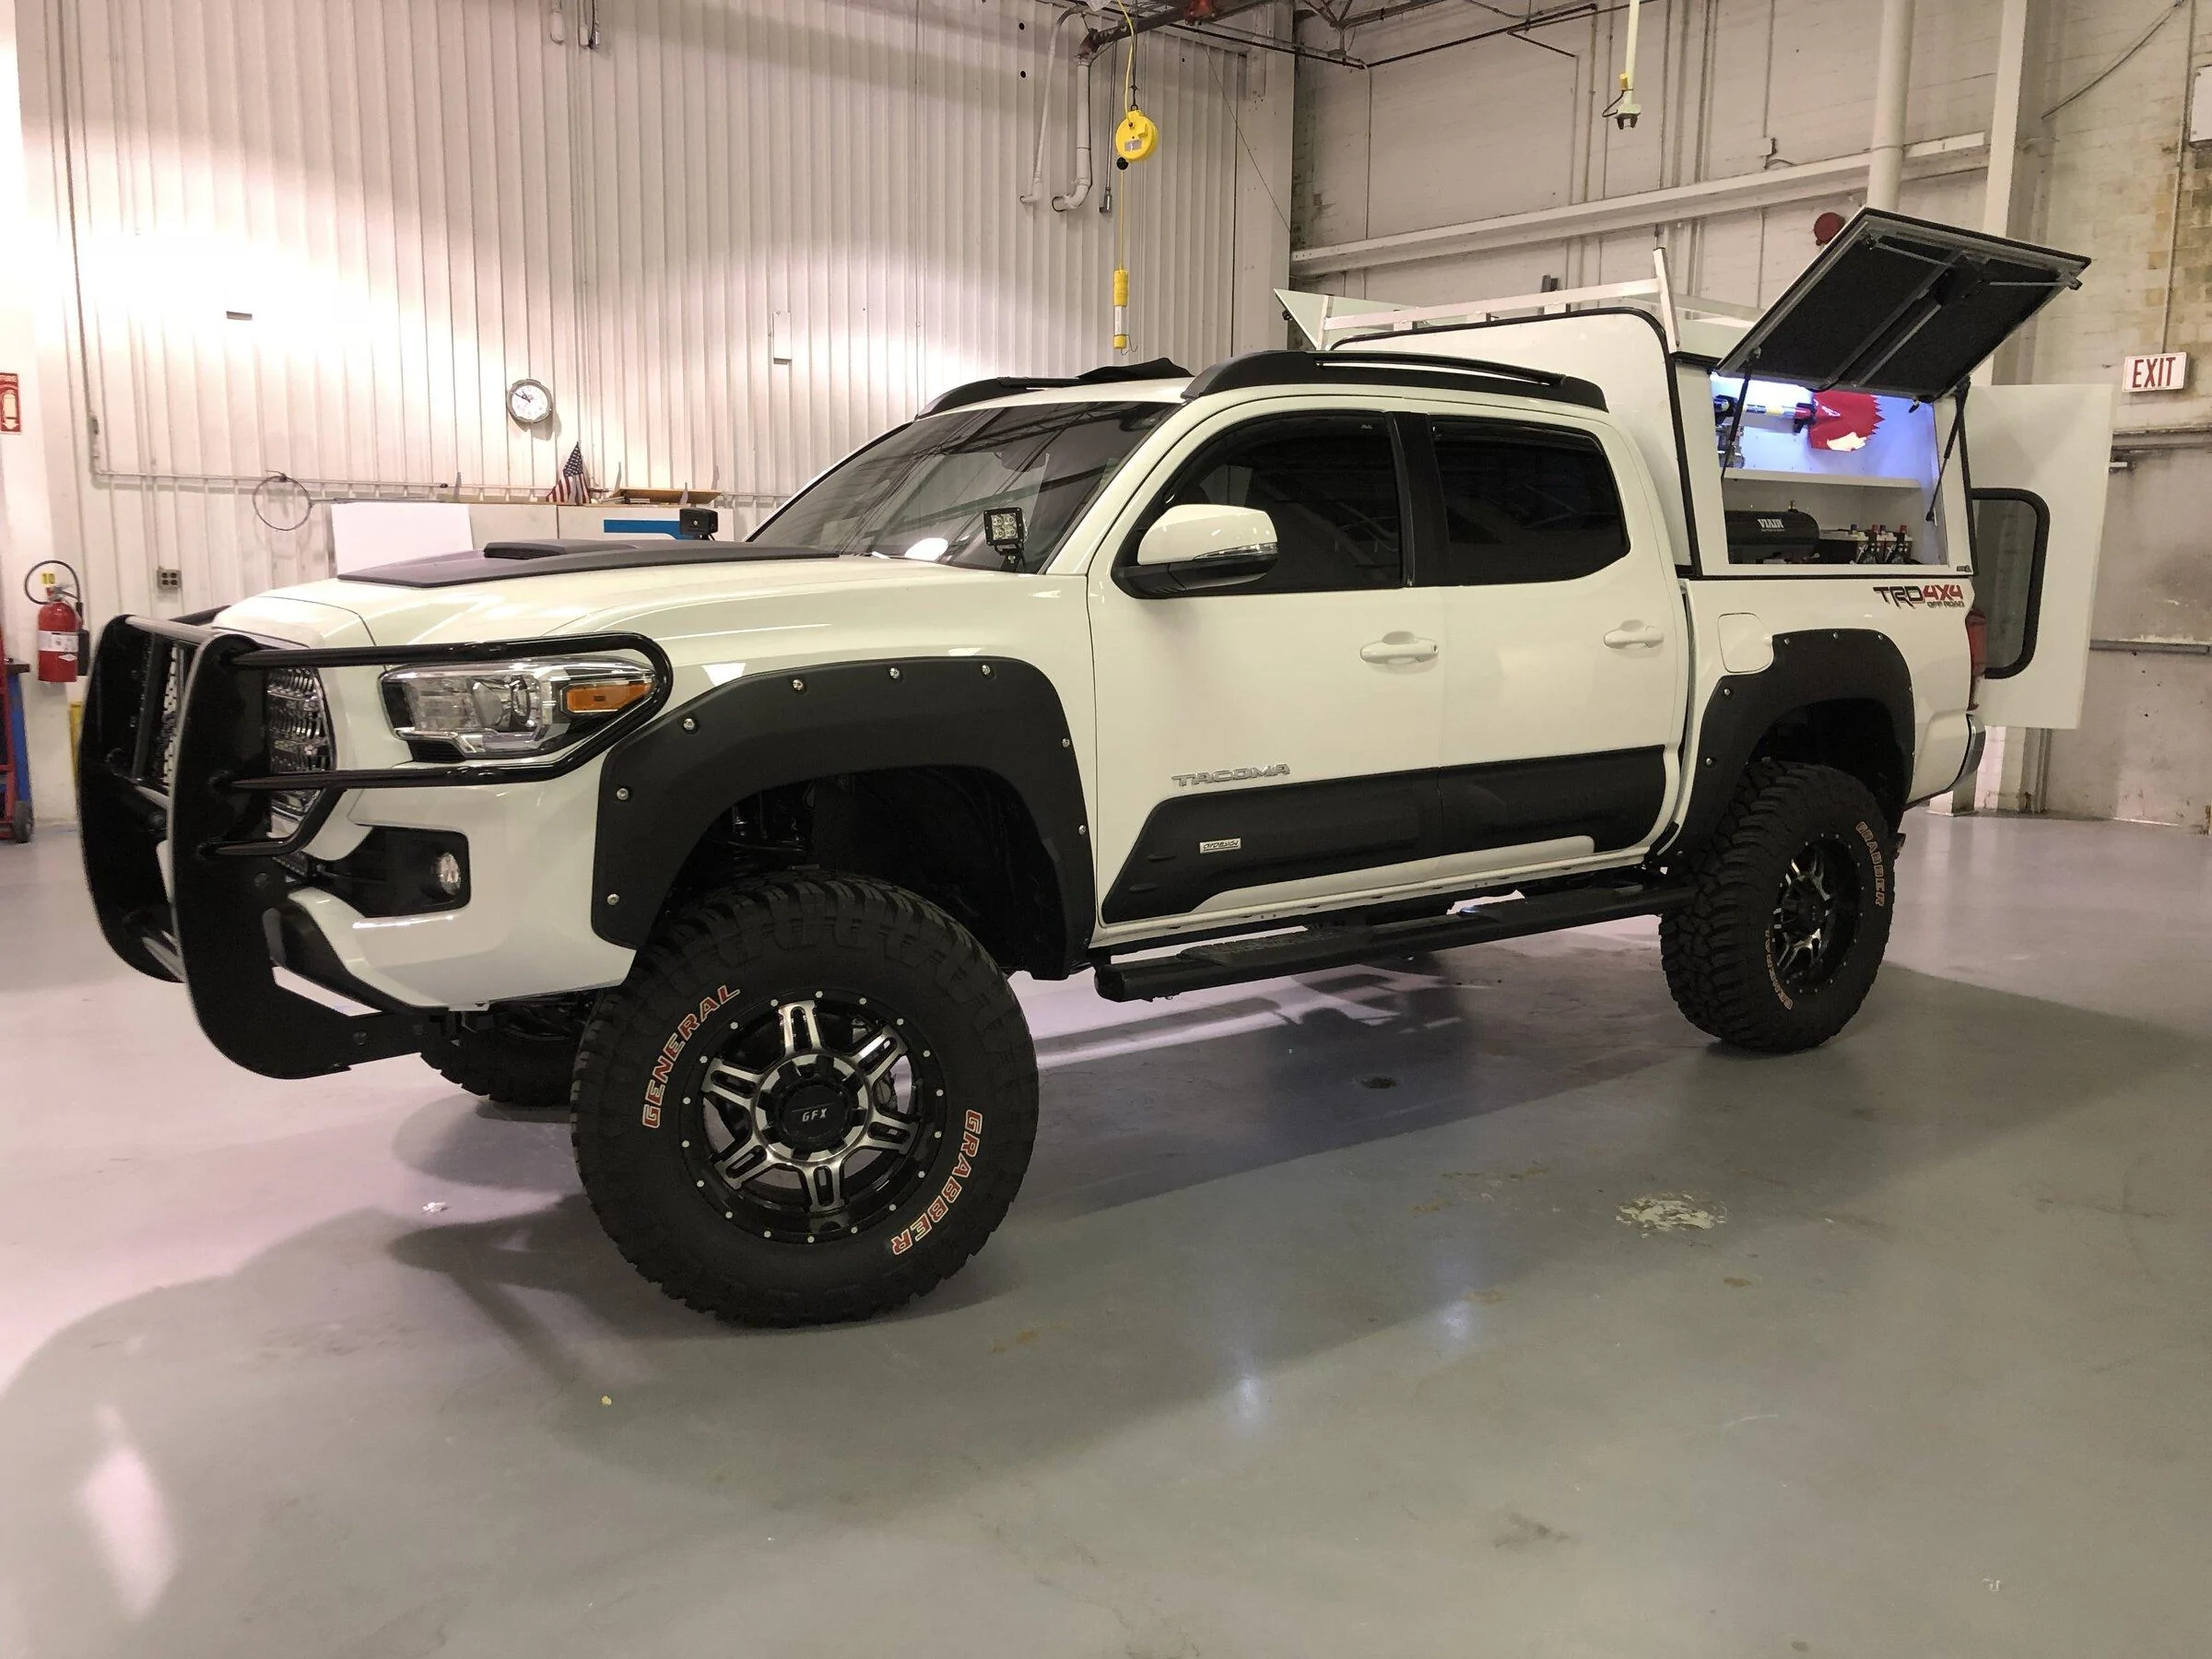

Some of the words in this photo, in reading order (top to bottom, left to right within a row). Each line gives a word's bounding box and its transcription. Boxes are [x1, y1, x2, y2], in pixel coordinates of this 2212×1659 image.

[2132, 357, 2176, 388] EXIT
[1757, 518, 1784, 529] VIAIR
[1171, 763, 1290, 787] TACOMA
[642, 984, 741, 1128] GENERAL
[802, 1108, 828, 1122] GFX
[891, 1109, 983, 1255] GRABBER
